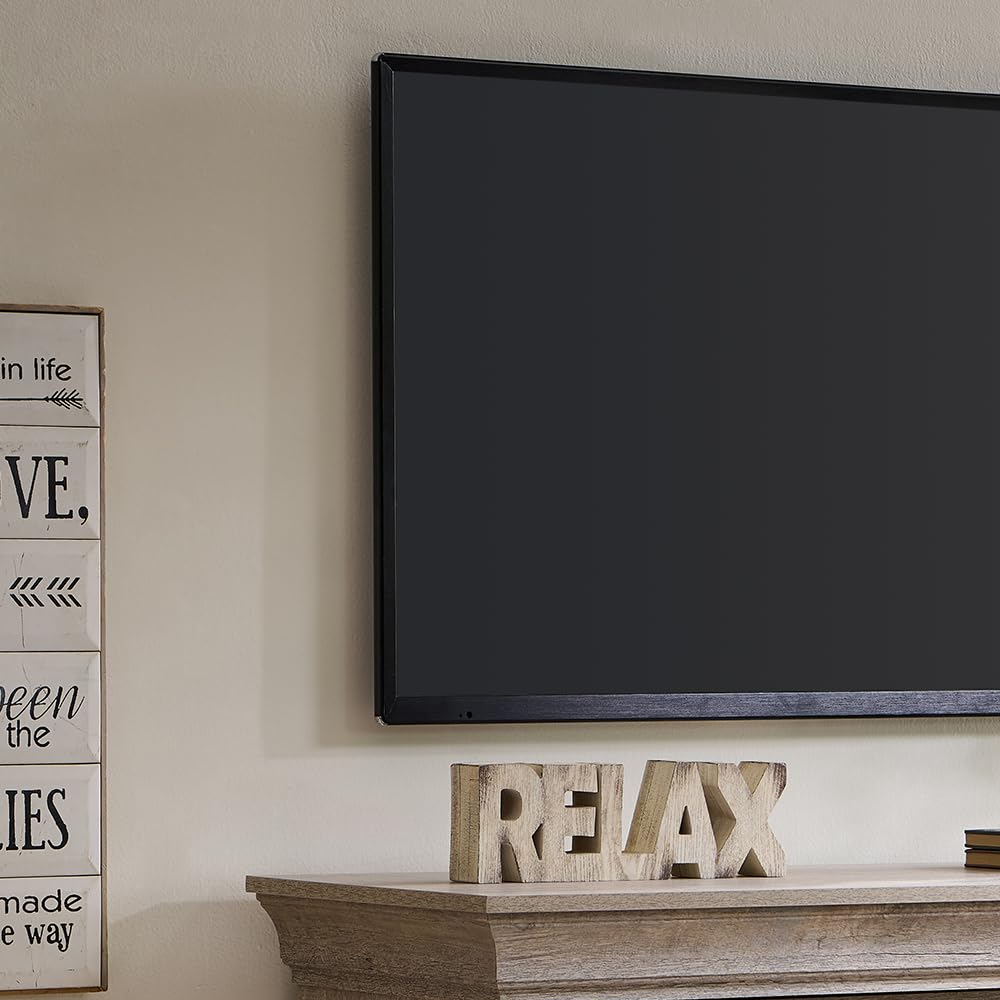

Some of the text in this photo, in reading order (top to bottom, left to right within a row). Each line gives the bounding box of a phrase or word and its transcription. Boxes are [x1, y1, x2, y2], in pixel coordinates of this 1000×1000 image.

[2, 357, 71, 380] in life
[6, 719, 51, 748] the
[0, 788, 69, 850] IES
[450, 760, 787, 884] RELAX
[24, 922, 74, 953] way
